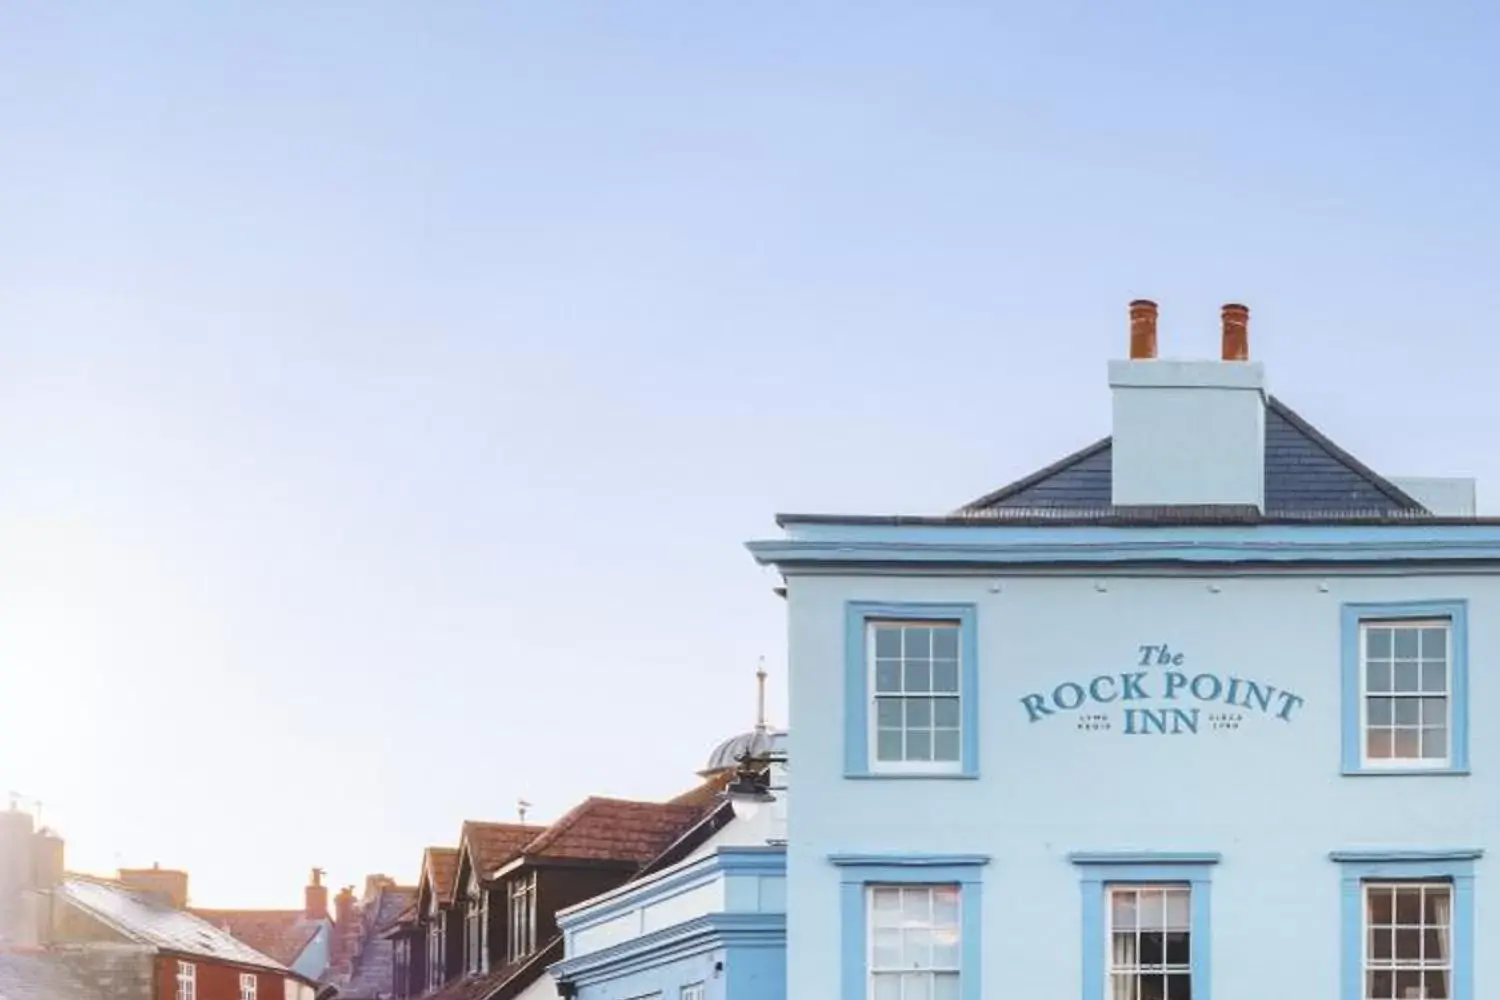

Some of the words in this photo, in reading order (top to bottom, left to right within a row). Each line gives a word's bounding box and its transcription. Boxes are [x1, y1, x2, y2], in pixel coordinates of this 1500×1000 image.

[1138, 644, 1185, 666] The
[1020, 671, 1152, 723] ROCK
[1165, 671, 1305, 723] POINT
[1123, 708, 1201, 734] INN
